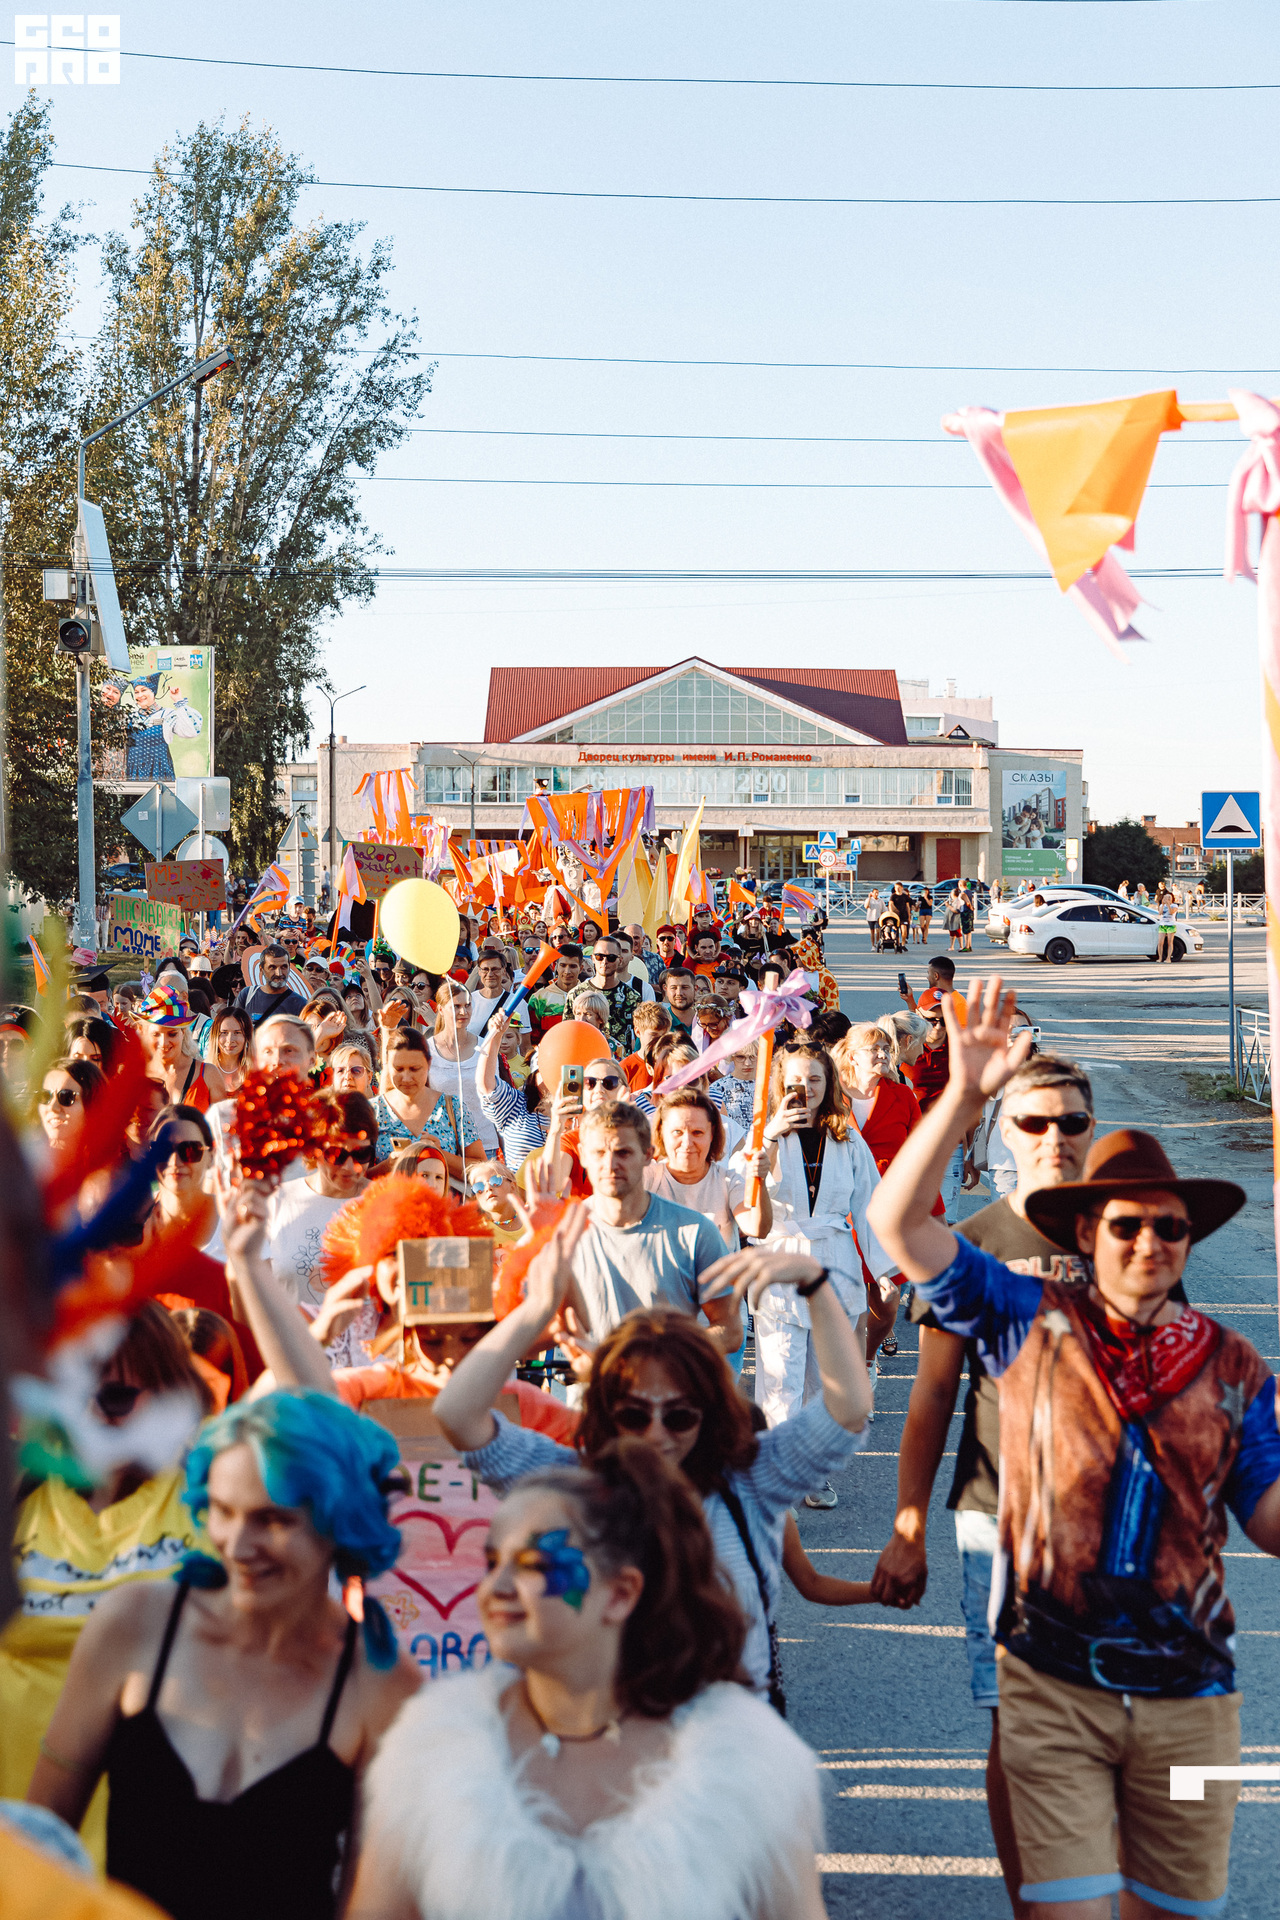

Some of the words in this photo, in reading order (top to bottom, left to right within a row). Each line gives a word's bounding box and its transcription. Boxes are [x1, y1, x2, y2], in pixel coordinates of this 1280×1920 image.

[578, 752, 620, 763] Дворец
[622, 754, 675, 764] культуры
[682, 754, 717, 762] имени
[751, 752, 813, 762] Романенко
[737, 773, 787, 792] 290
[1011, 772, 1054, 783] СКАЗЫ
[822, 855, 834, 863] 20
[154, 865, 183, 883] МЫ
